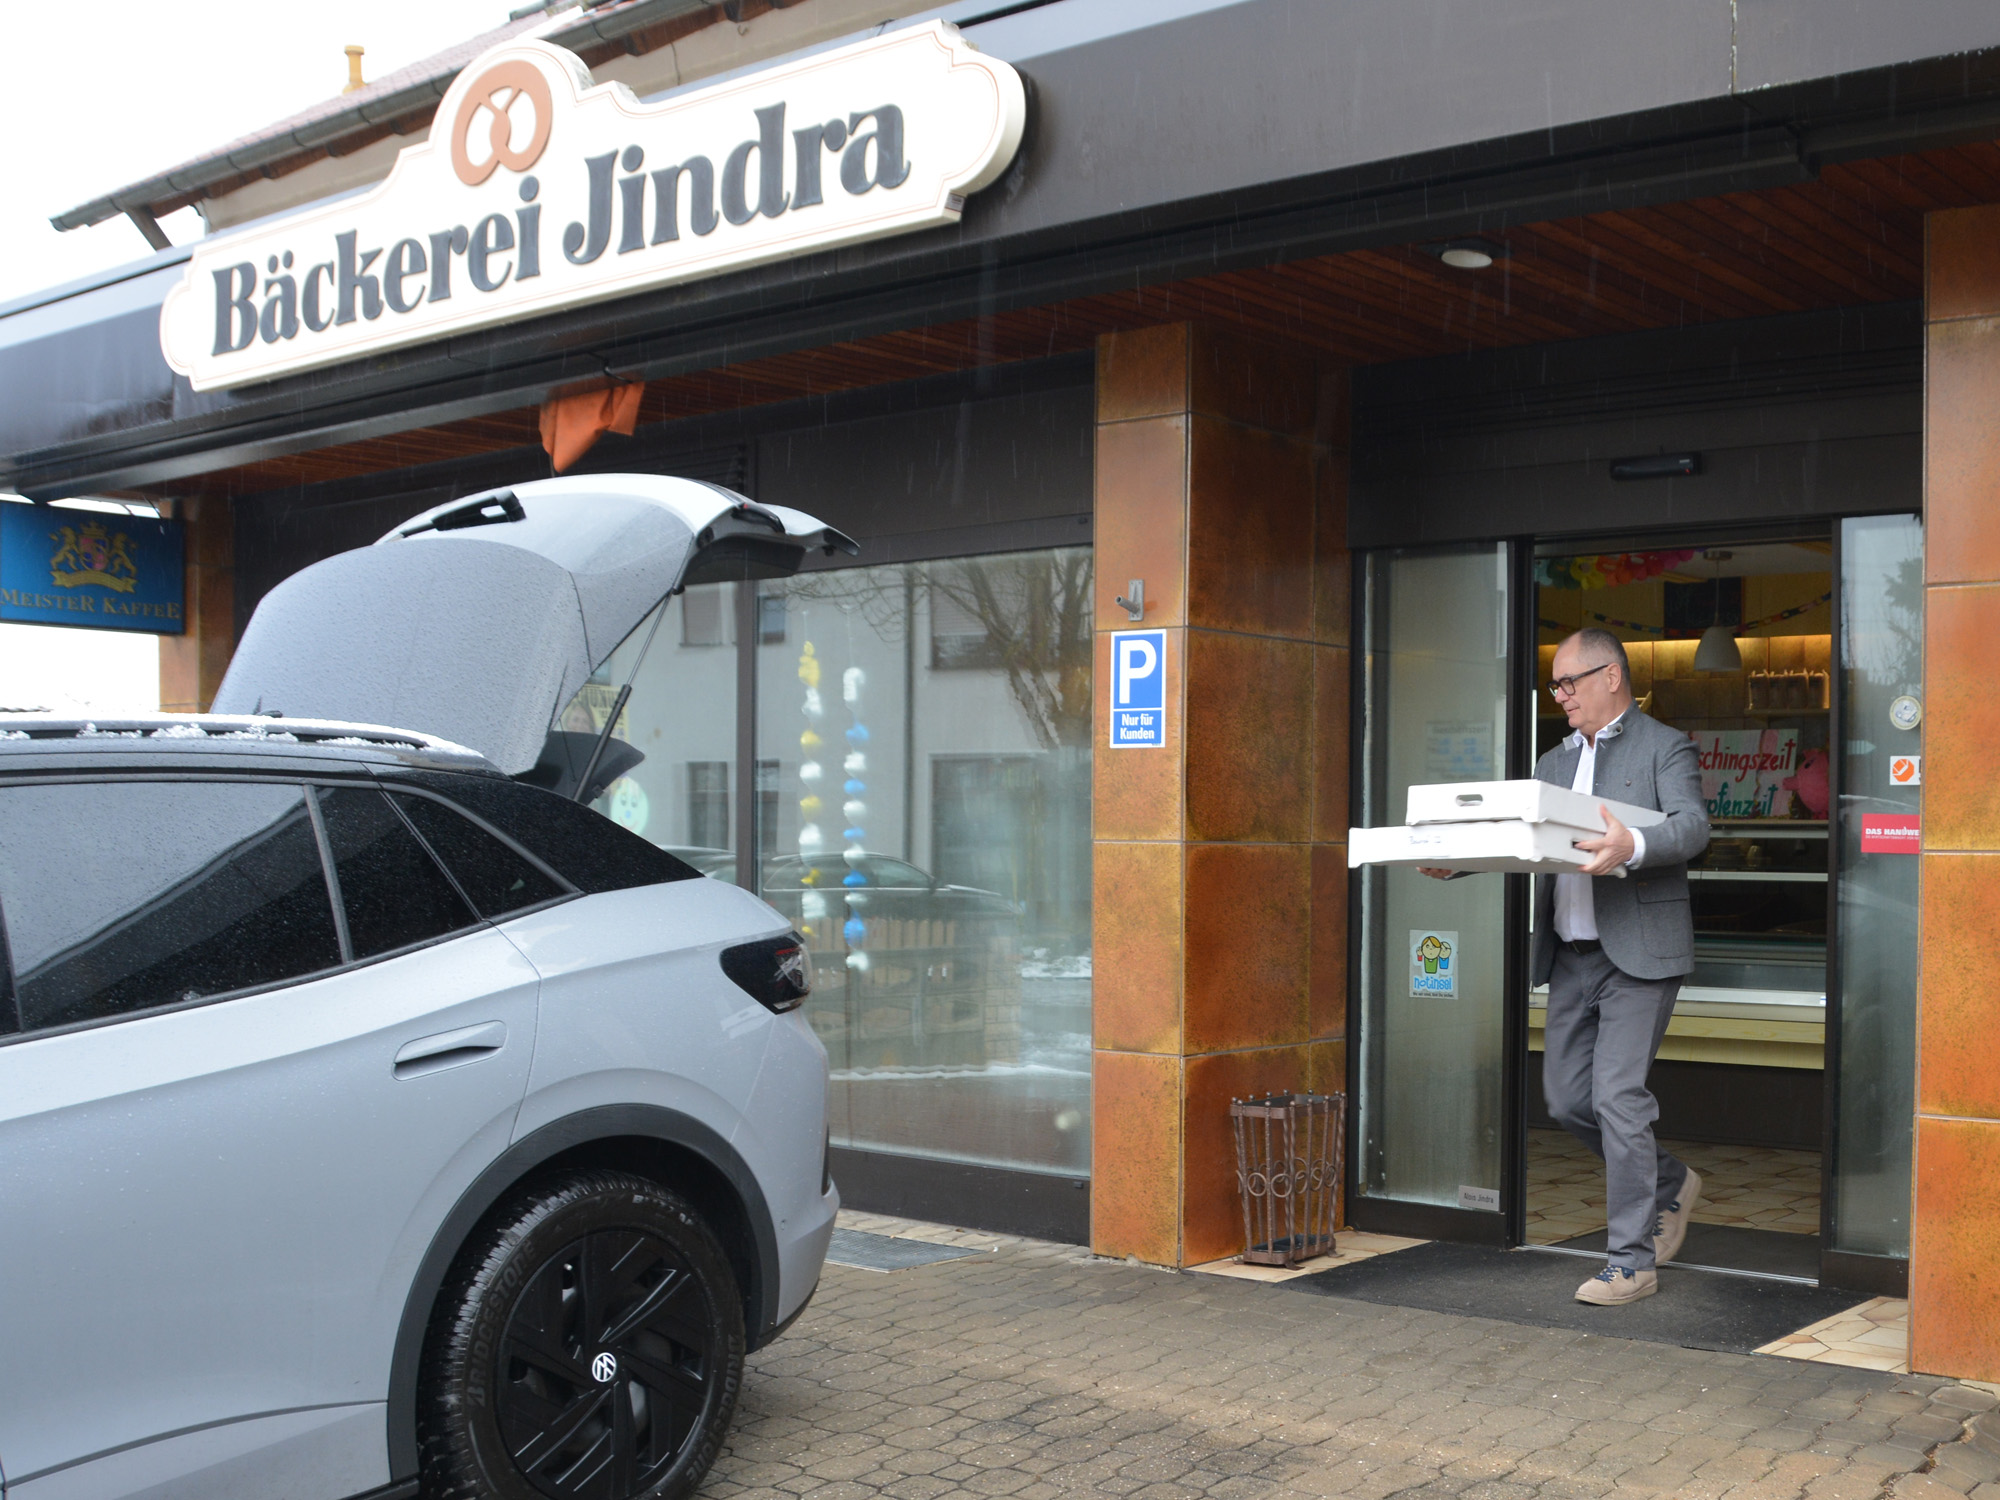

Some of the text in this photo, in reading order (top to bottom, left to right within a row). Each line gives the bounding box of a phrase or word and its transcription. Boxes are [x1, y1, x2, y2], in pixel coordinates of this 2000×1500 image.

[211, 101, 911, 357] Bäckerei Jindra
[0, 588, 181, 619] MEISTER KAFFEE
[1119, 640, 1157, 704] P
[1121, 713, 1154, 726] Nur für
[1120, 727, 1155, 740] Kunden
[1414, 976, 1452, 990] notinsel
